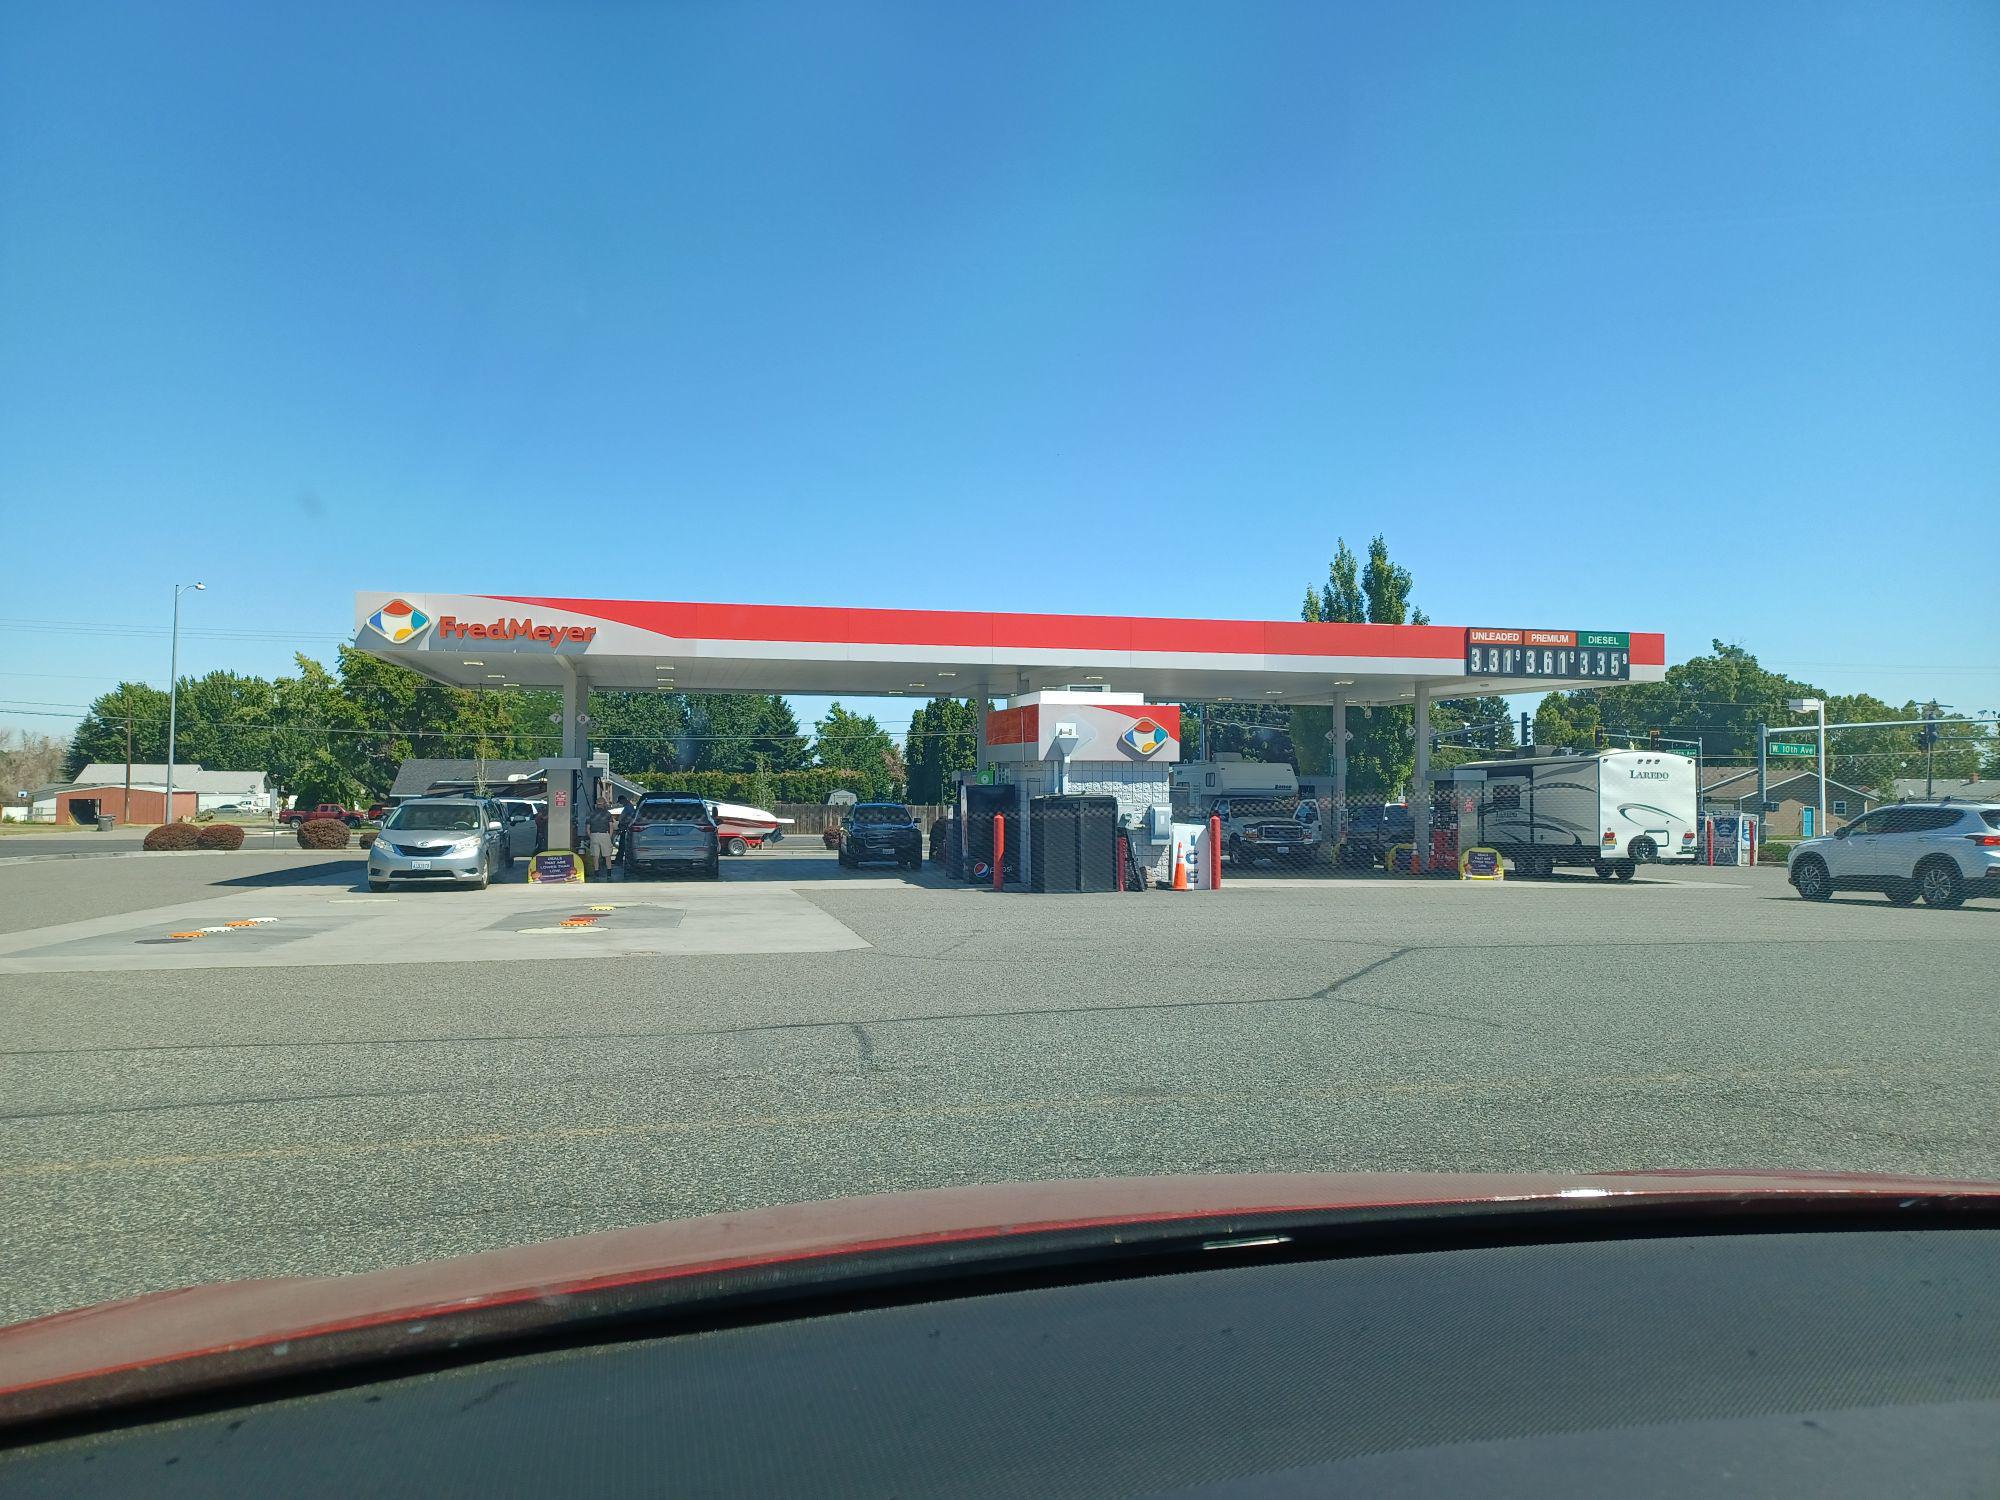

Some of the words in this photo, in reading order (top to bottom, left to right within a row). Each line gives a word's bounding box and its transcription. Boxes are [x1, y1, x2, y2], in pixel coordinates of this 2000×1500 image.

[1471, 631, 1520, 642] UNLEADED
[1531, 632, 1569, 643] PREMIUM
[1588, 635, 1619, 645] DIESEL
[1782, 745, 1798, 753] 10th
[1800, 746, 1814, 755] Ave
[1629, 769, 1669, 780] LAREDO
